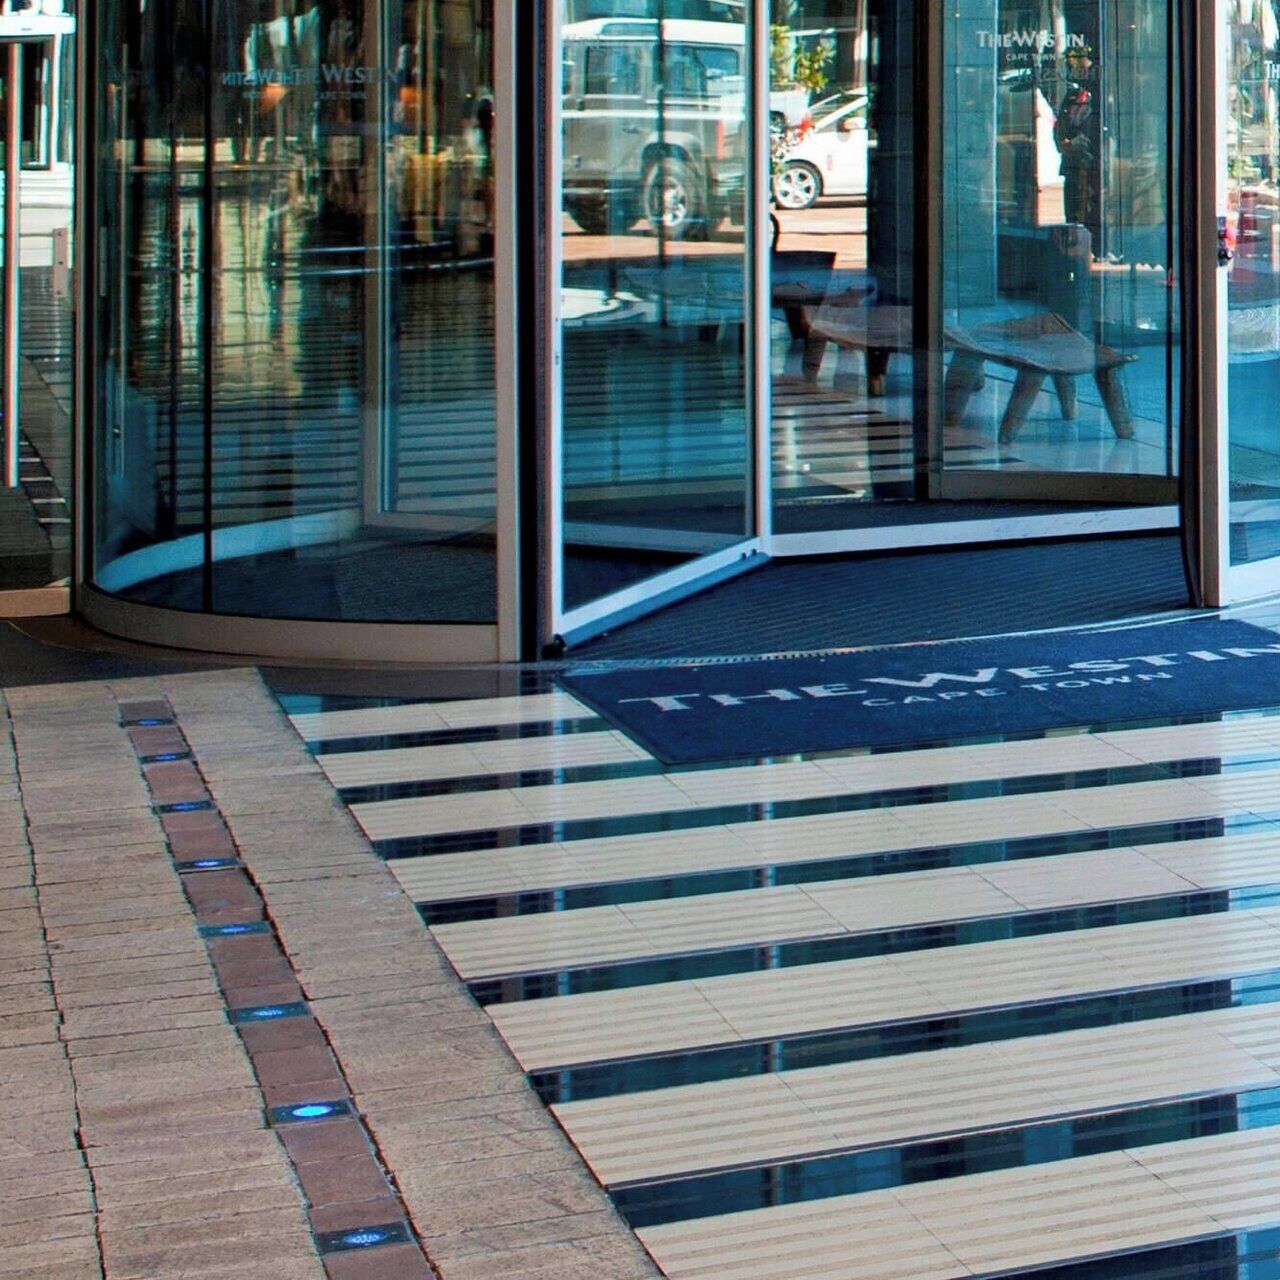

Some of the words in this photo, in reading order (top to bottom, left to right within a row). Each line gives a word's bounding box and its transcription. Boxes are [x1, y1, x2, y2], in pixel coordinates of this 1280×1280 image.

[1011, 30, 1084, 49] WSIN
[618, 683, 868, 712] THE
[862, 686, 1007, 708] CAPE
[1021, 671, 1174, 692] TOWN
